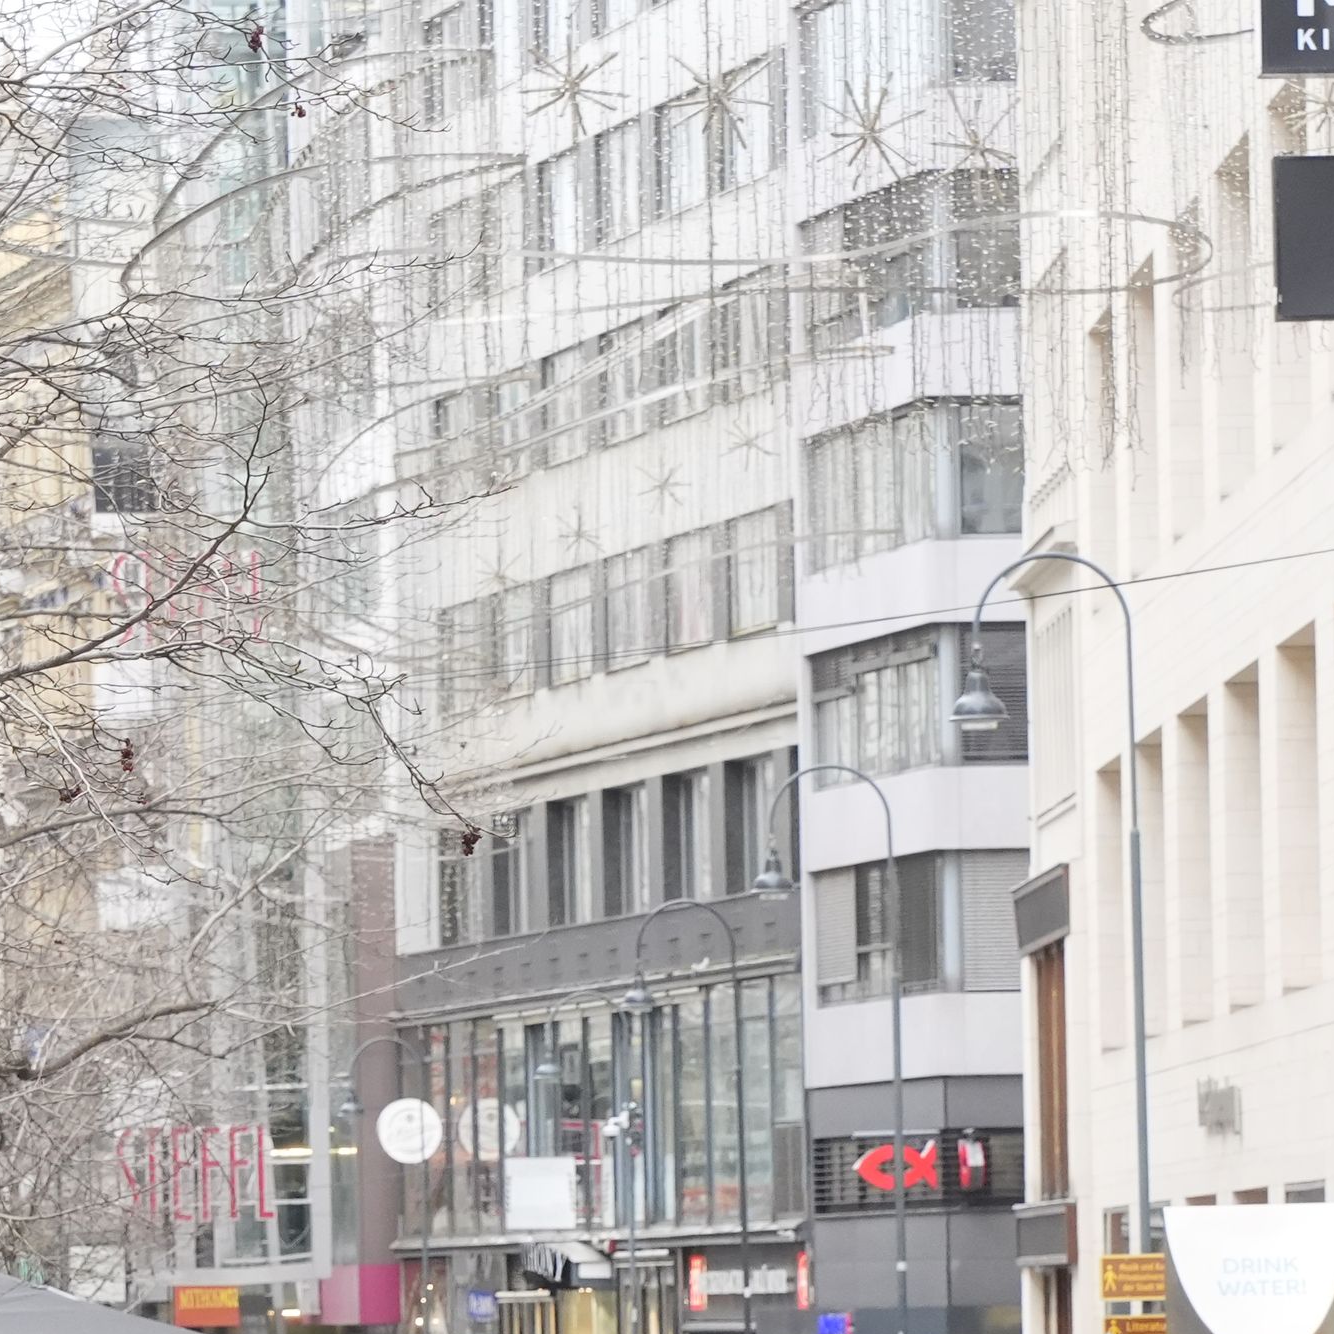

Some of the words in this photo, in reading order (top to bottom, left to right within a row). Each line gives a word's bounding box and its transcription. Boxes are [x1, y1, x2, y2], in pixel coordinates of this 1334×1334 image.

[117, 1125, 274, 1220] STEFFL
[1222, 1257, 1299, 1274] DRINK
[1217, 1278, 1308, 1297] WATER!
